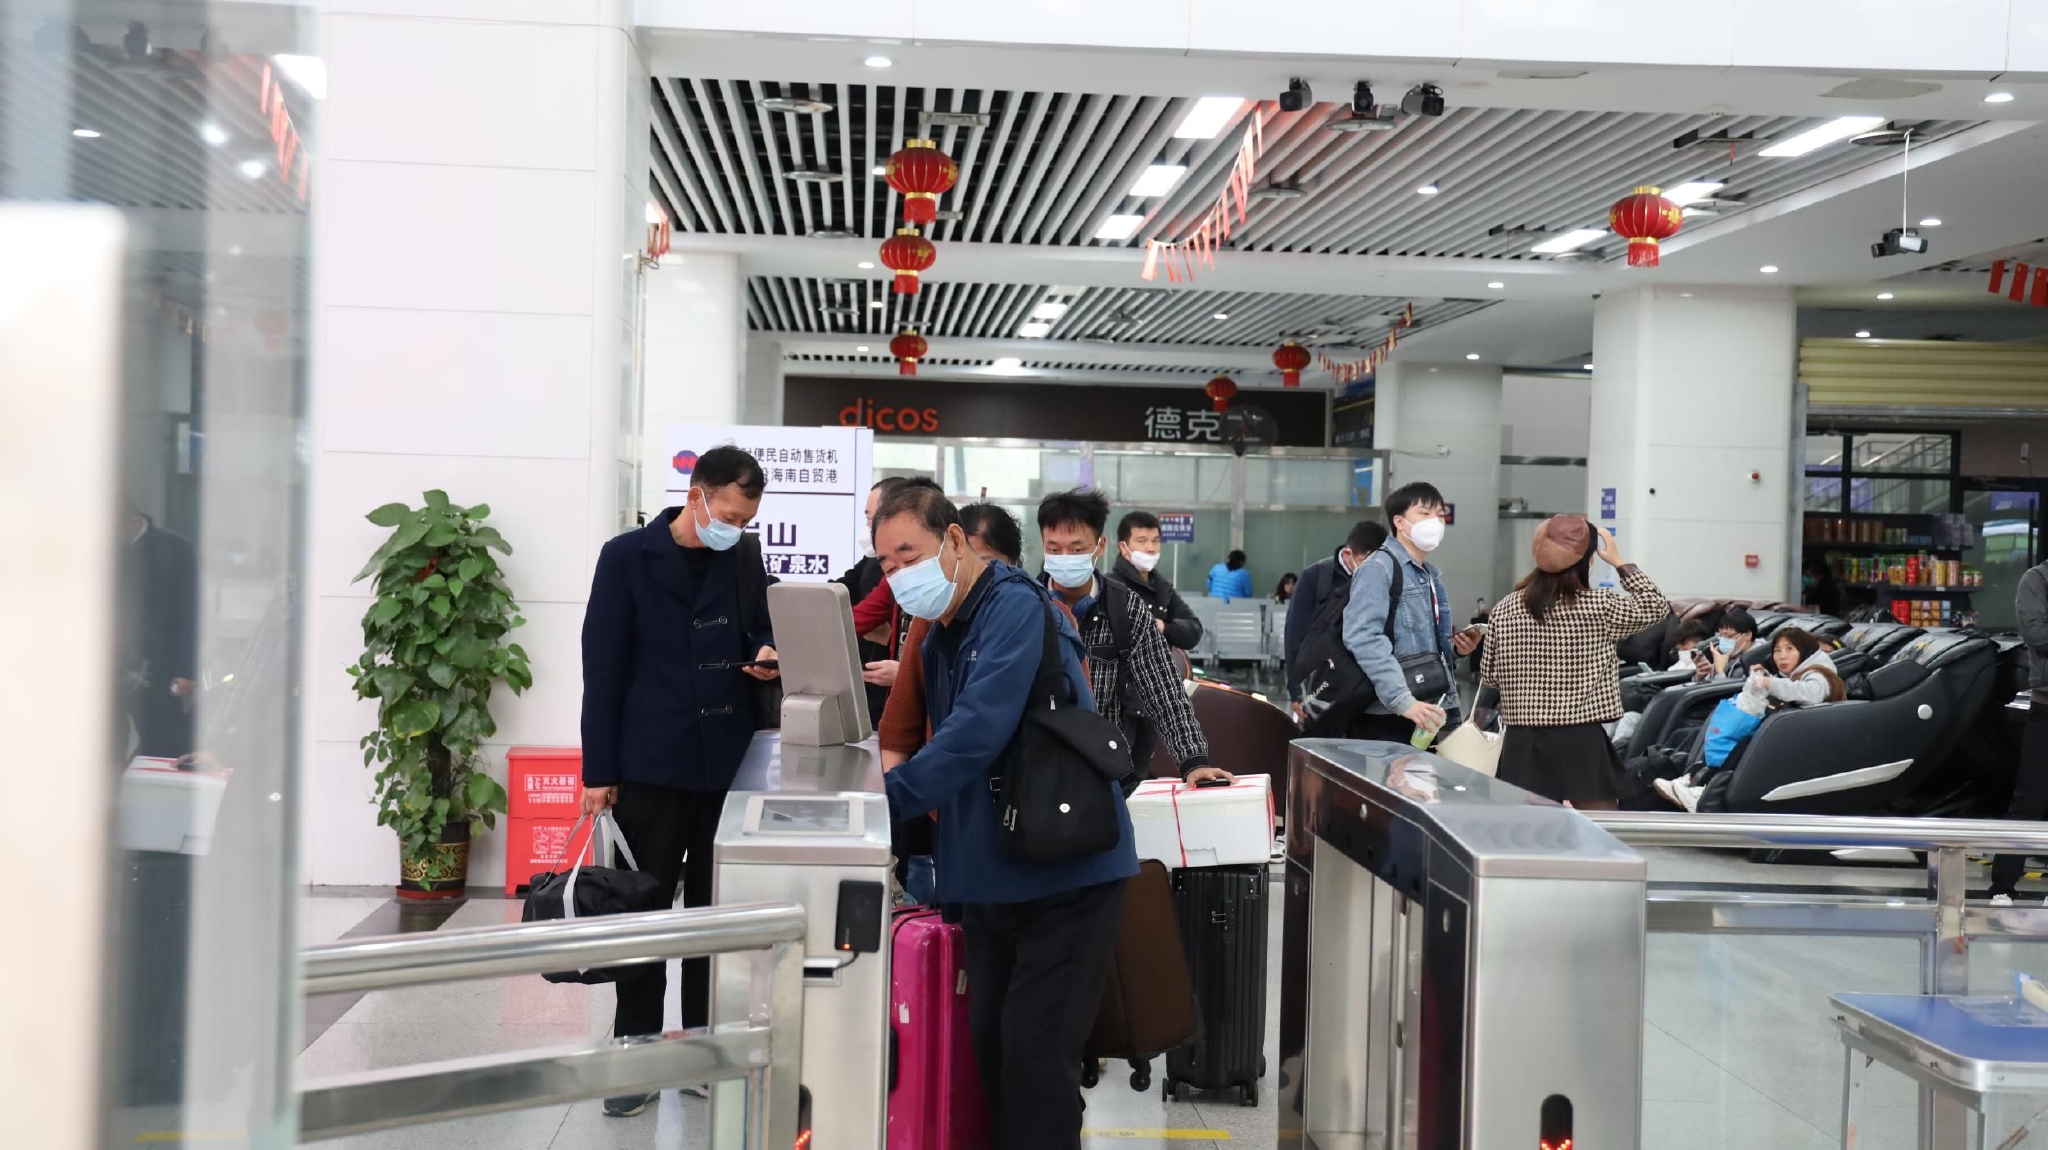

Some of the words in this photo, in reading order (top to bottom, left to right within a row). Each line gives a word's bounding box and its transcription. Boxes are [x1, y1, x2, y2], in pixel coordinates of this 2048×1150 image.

[840, 397, 939, 432] dicos
[741, 447, 838, 464] 便民自动售货机
